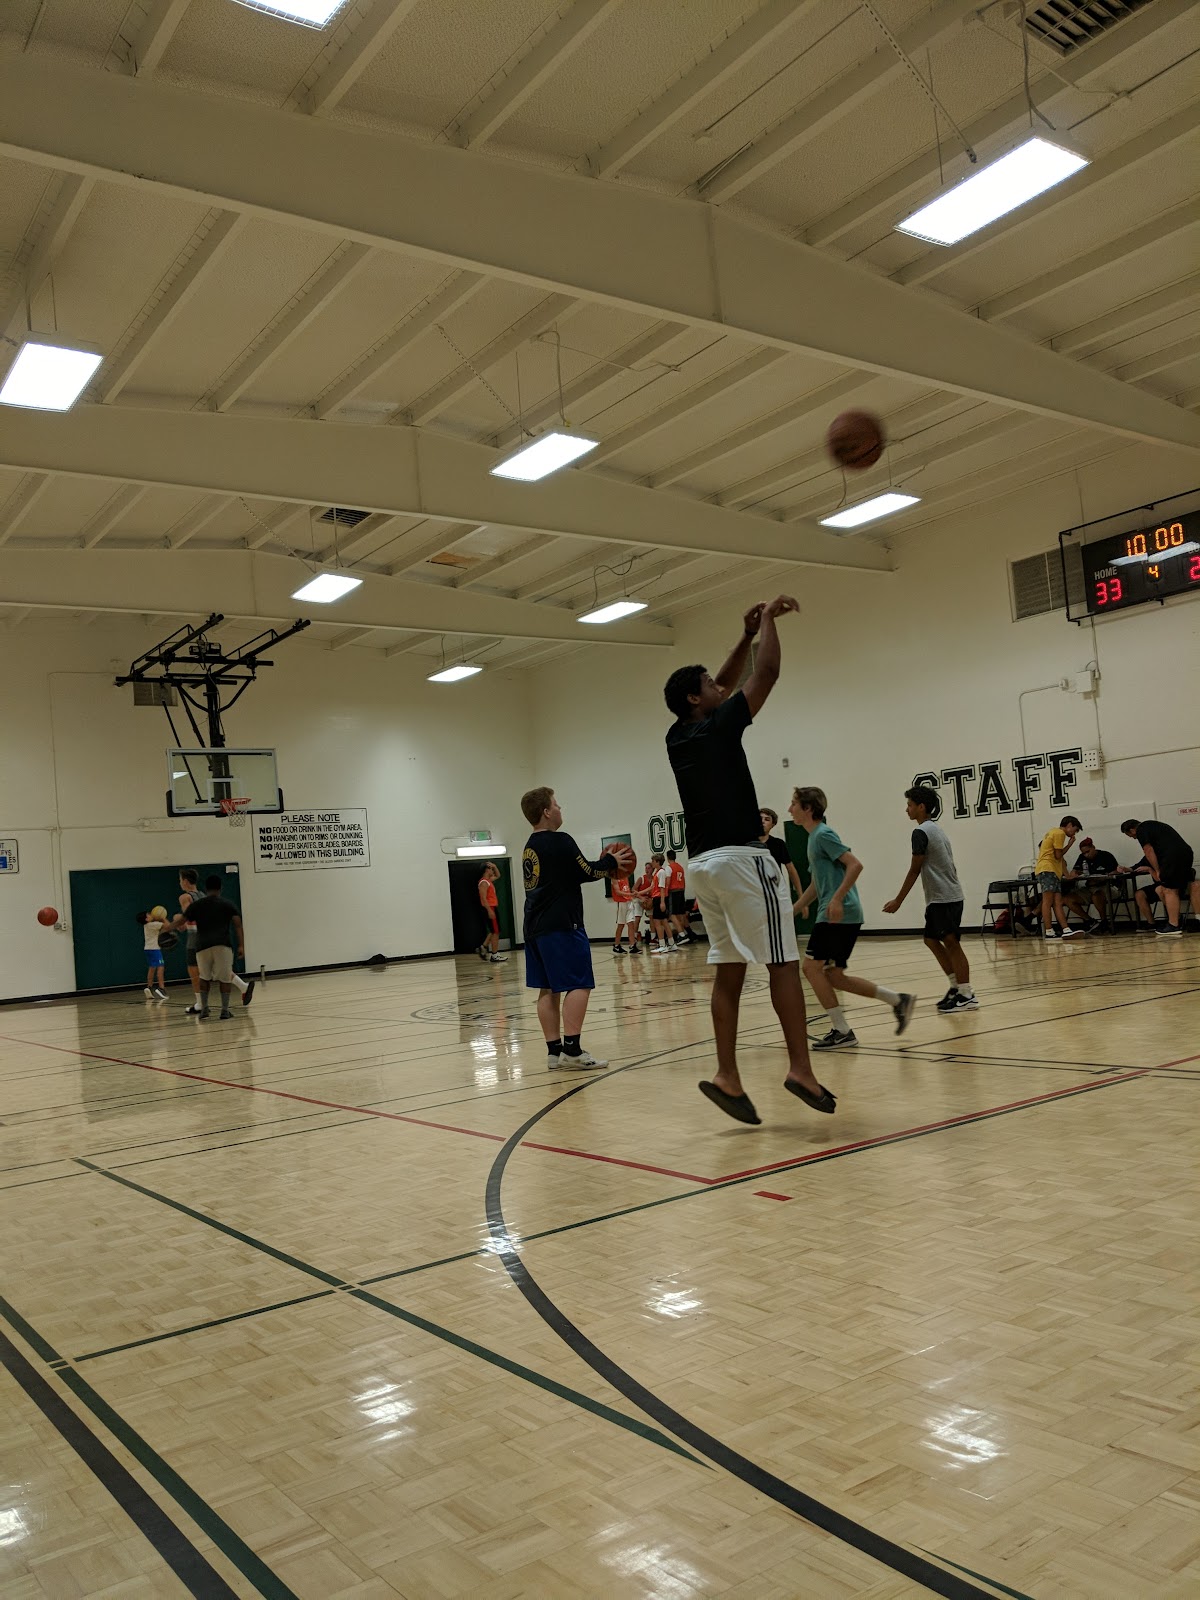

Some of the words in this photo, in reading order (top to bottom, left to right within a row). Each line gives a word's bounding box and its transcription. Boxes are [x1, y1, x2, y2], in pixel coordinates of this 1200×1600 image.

[1094, 566, 1118, 580] HOME
[1148, 565, 1159, 578] 4
[1096, 578, 1123, 605] 33
[911, 747, 1083, 821] STAFF
[275, 851, 306, 859] ALLOWED
